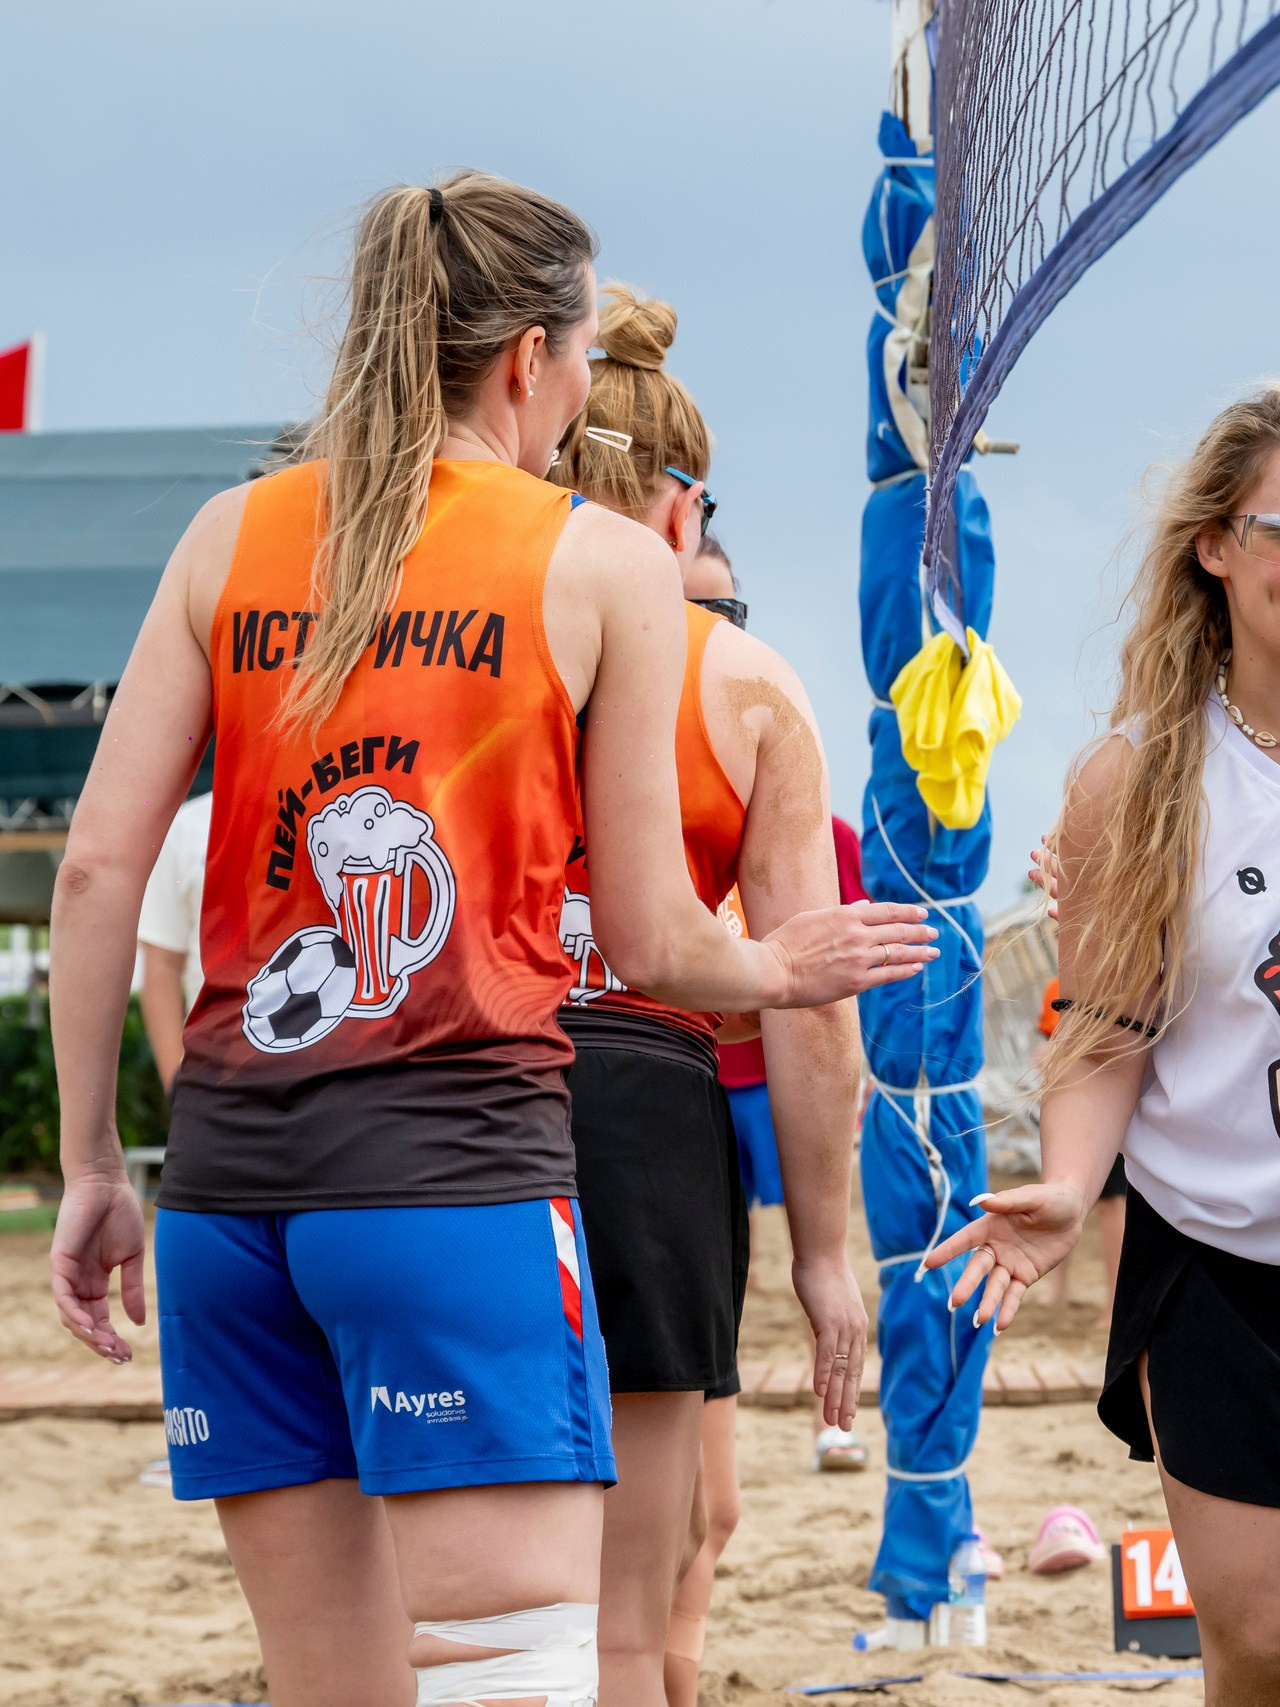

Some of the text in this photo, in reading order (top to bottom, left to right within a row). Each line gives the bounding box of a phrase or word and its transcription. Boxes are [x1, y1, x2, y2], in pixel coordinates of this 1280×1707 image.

[232, 609, 505, 678] ИСТИЧКА
[265, 735, 421, 891] ПЕЙ-БЕГИ
[395, 1390, 466, 1417] Ayres
[1126, 1538, 1187, 1607] 14
